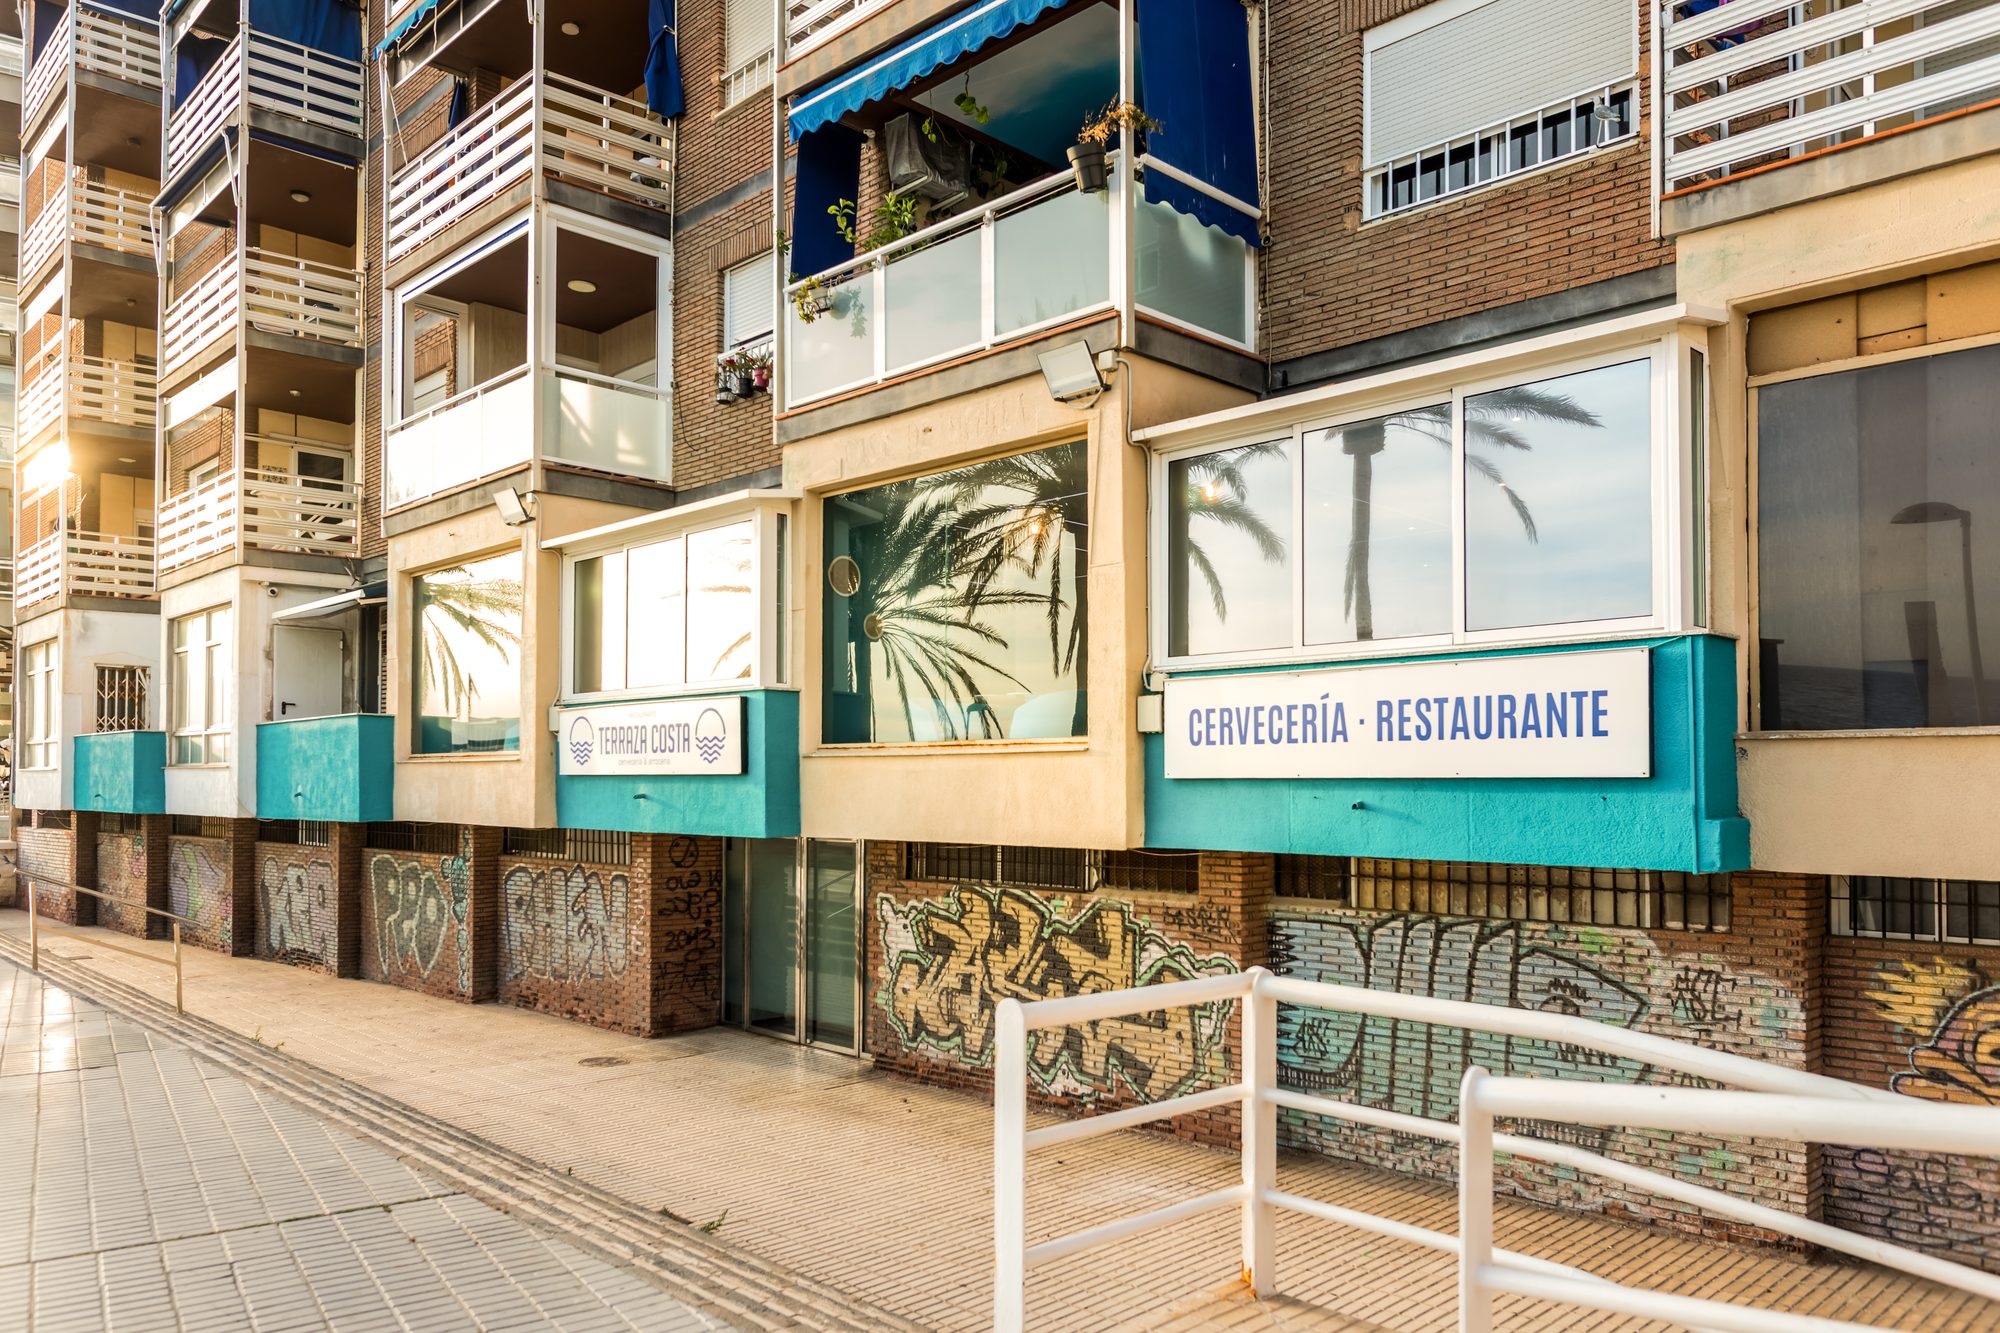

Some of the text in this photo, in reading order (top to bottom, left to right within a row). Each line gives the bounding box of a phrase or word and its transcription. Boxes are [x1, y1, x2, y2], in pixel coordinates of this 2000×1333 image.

[598, 723, 691, 755] TERRAZA COSTA
[1188, 692, 1349, 747] CERVECERÍA
[1376, 689, 1610, 743] RESTAURANTE
